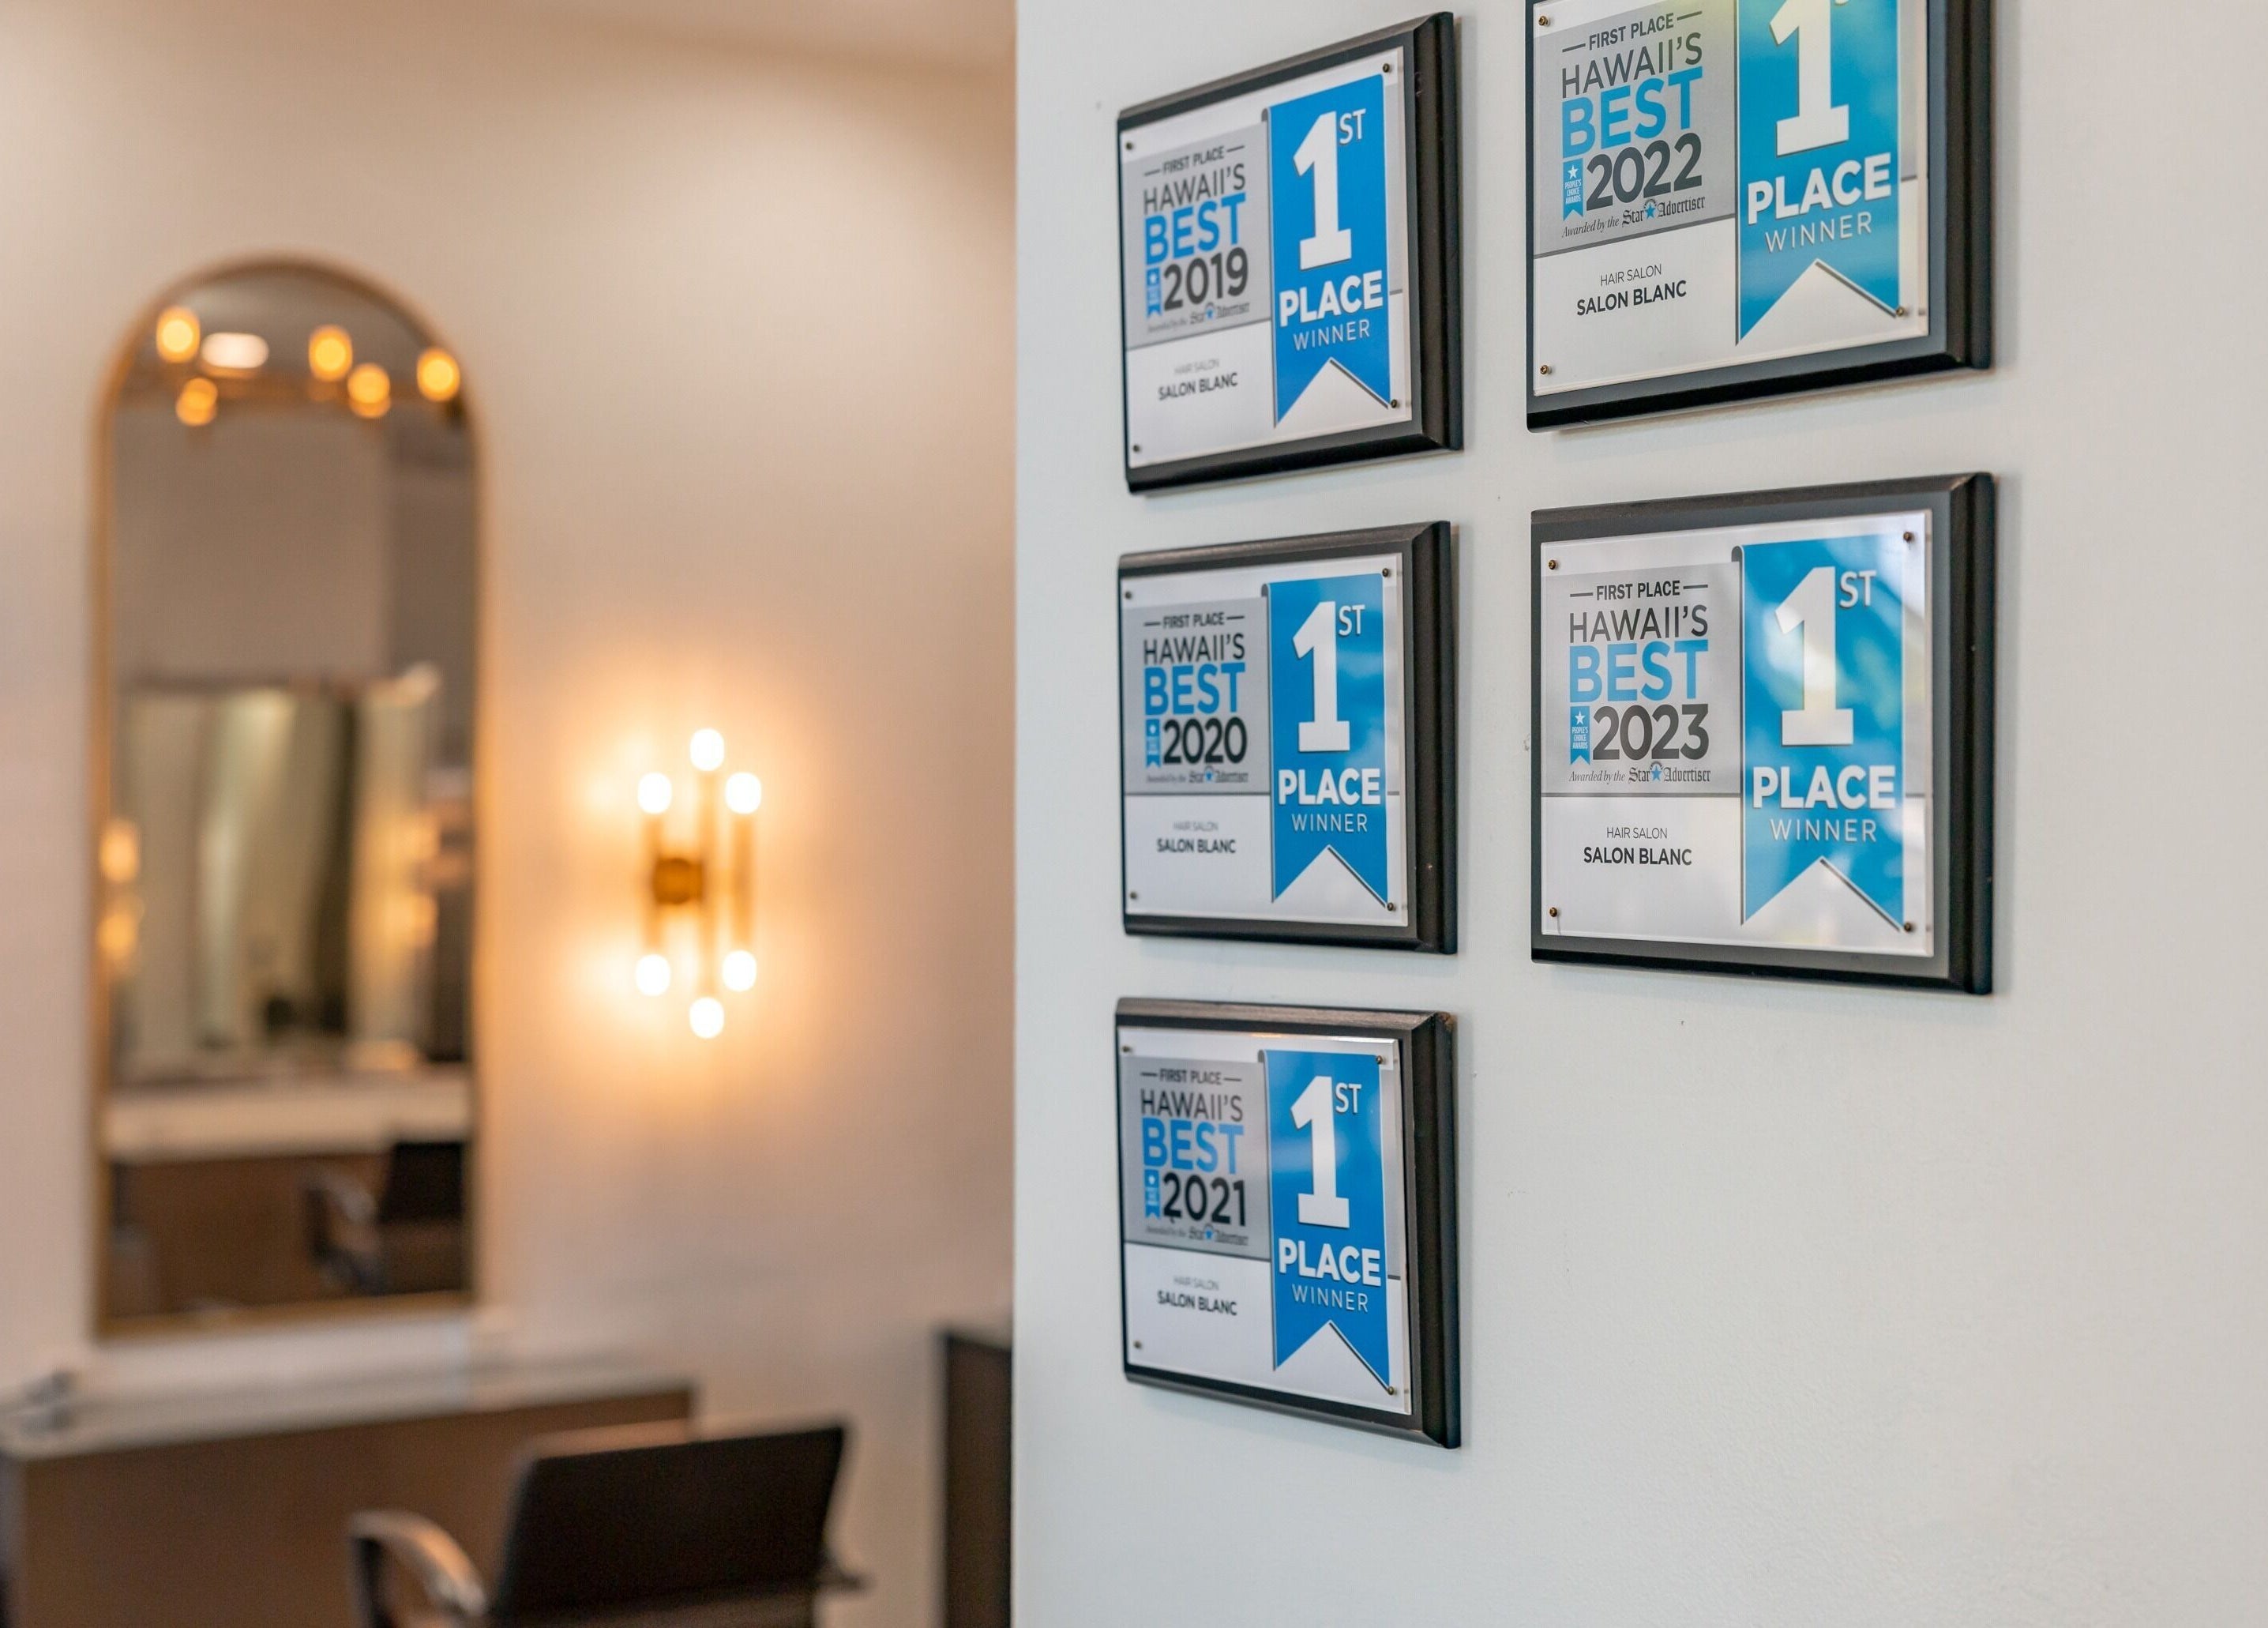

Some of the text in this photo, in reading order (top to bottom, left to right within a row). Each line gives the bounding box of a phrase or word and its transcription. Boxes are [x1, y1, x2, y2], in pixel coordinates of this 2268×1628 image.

[1588, 13, 1674, 51] FIRST PLACE
[1561, 32, 1703, 99] HAWAII'S
[1561, 66, 1703, 158] BEST
[1162, 145, 1225, 175] FIRST PLACE
[1586, 132, 1703, 212] 2022
[1143, 163, 1245, 215] HAWAII'S
[1747, 152, 1892, 225] PLACE
[1144, 192, 1246, 265] BEST
[1562, 196, 1706, 238] Awarded by the Star Advertiser
[1765, 212, 1872, 254] WINNER
[1163, 246, 1249, 311] 2019
[1600, 263, 1662, 287] HAIR SALON
[1279, 269, 1384, 327] PLACE
[1576, 279, 1687, 316] SALON BLANC
[1293, 319, 1371, 351] WINNER
[1158, 372, 1238, 400] SALON BLANC
[1596, 580, 1680, 601] FIRST PLACE
[1163, 611, 1225, 629] FIRST PLACE
[1569, 604, 1708, 644] HAWAII'S
[1143, 633, 1245, 666] HAWAII'S
[1143, 662, 1245, 716] BEST
[1568, 639, 1708, 703] BEST
[1162, 716, 1248, 765] 2020
[1593, 703, 1709, 761] 2023
[1278, 768, 1382, 806] PLACE
[1568, 766, 1711, 785] Awarded by the Star Advertiser
[1752, 765, 1895, 811] PLACE
[1291, 813, 1368, 833] WINNER
[1606, 826, 1668, 840] HAIR SALON
[1770, 818, 1876, 843] WINNER
[1157, 838, 1237, 854] SALON BLANC
[1583, 847, 1692, 866] SALON BLANC
[1159, 1068, 1222, 1085] FIRST PLACE
[1140, 1088, 1243, 1122] HAWAII'S
[1142, 1118, 1245, 1175] BEST
[1163, 1172, 1246, 1227] 2021
[1278, 1238, 1382, 1288] PLACE
[1157, 1290, 1237, 1317] SALON BLANC
[1291, 1283, 1369, 1313] WINNER
